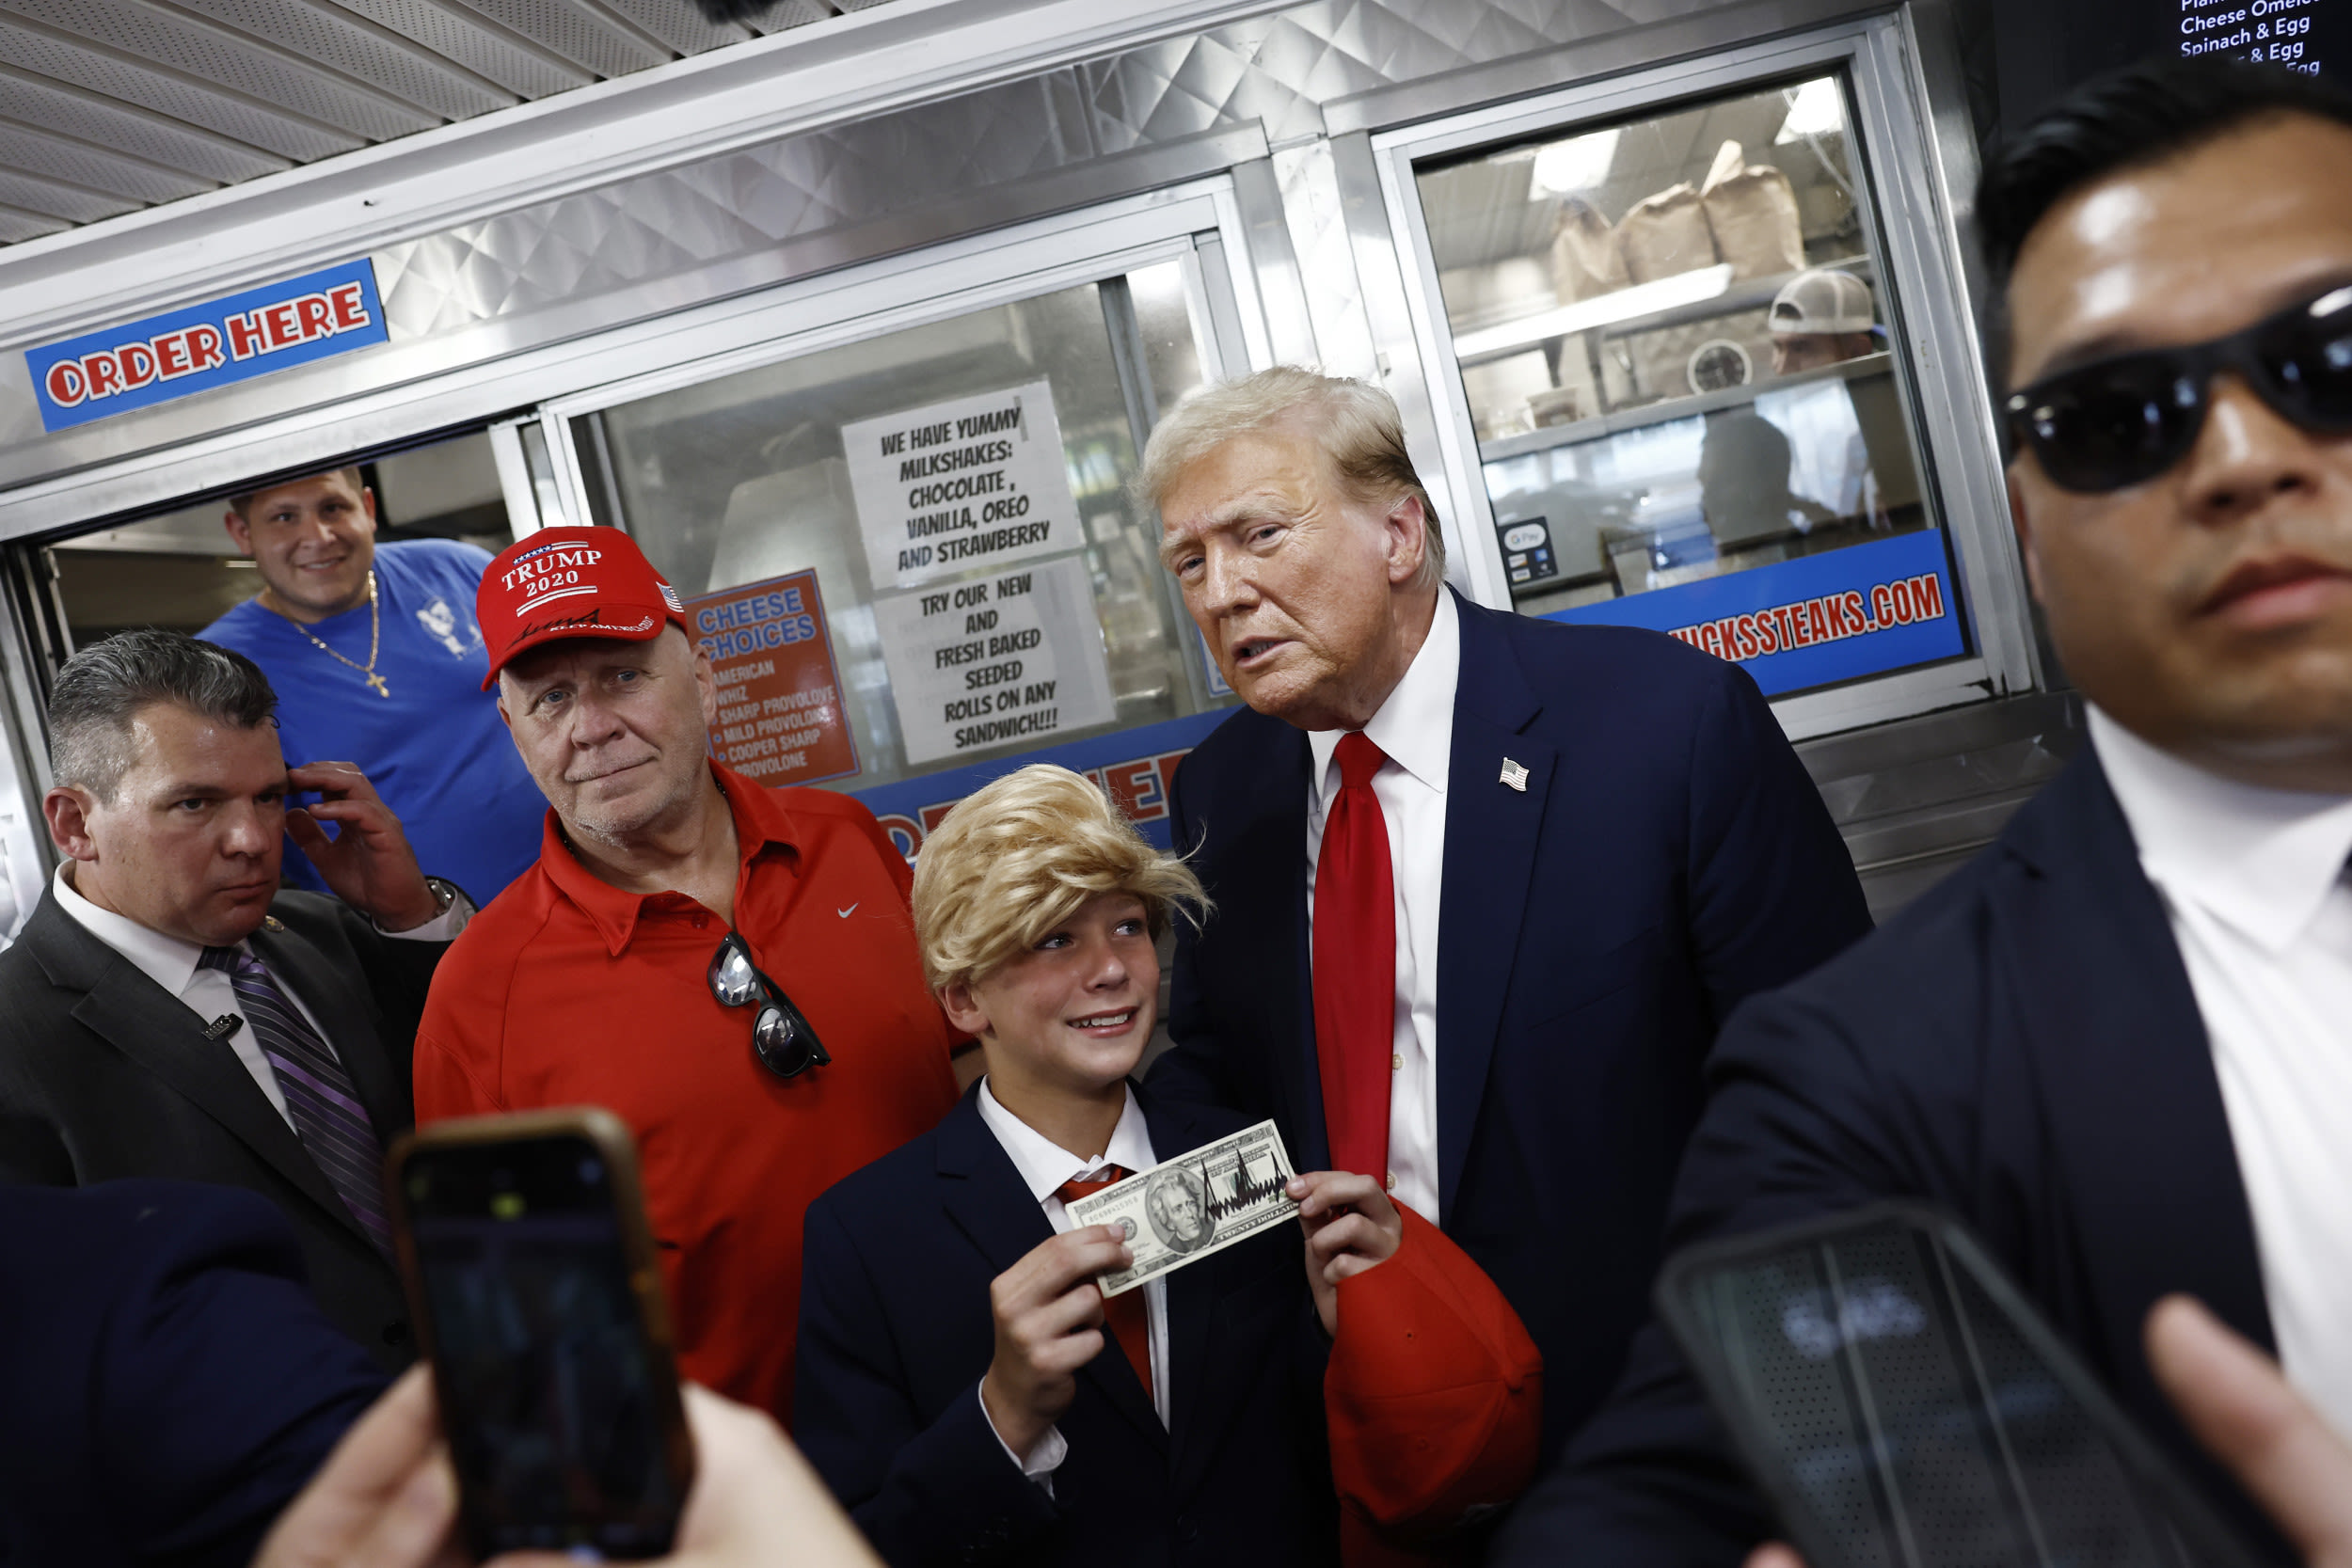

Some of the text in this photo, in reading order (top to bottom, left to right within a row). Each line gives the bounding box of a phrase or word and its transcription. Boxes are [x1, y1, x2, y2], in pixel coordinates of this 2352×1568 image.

[2181, 0, 2319, 35] Cheese Ome
[2181, 16, 2311, 57] Spinach & Egg
[2250, 41, 2304, 63] & Egg
[46, 280, 371, 407] ORDER HERE
[882, 406, 1021, 456] WE HAVE YUMMY
[900, 440, 1013, 482] MILKSHAKES:
[909, 470, 1006, 509] CHOCOLATE
[907, 495, 1029, 540] VANILLA, OREO
[898, 520, 1050, 571] AND STRAWBERRY
[501, 550, 602, 592] TRUMP
[527, 571, 578, 597] 2020
[697, 587, 803, 633] CHEESE
[921, 573, 1032, 616] TRY OUR NEW
[966, 610, 998, 634] AND
[935, 628, 1041, 669] FRESH BAKED
[713, 659, 775, 687] AMERICAN
[964, 660, 1023, 690] SEEDED
[718, 686, 749, 705] WHIZ
[719, 702, 760, 725] SHARP
[945, 681, 1056, 722] ROLLS ON ANY
[723, 723, 755, 743] MILD
[728, 728, 820, 763] COOPER SHARP
[955, 707, 1057, 748] SANDWICH!!!
[735, 751, 807, 778] PROVOLONE
[1217, 1221, 1258, 1241] TWENTY
